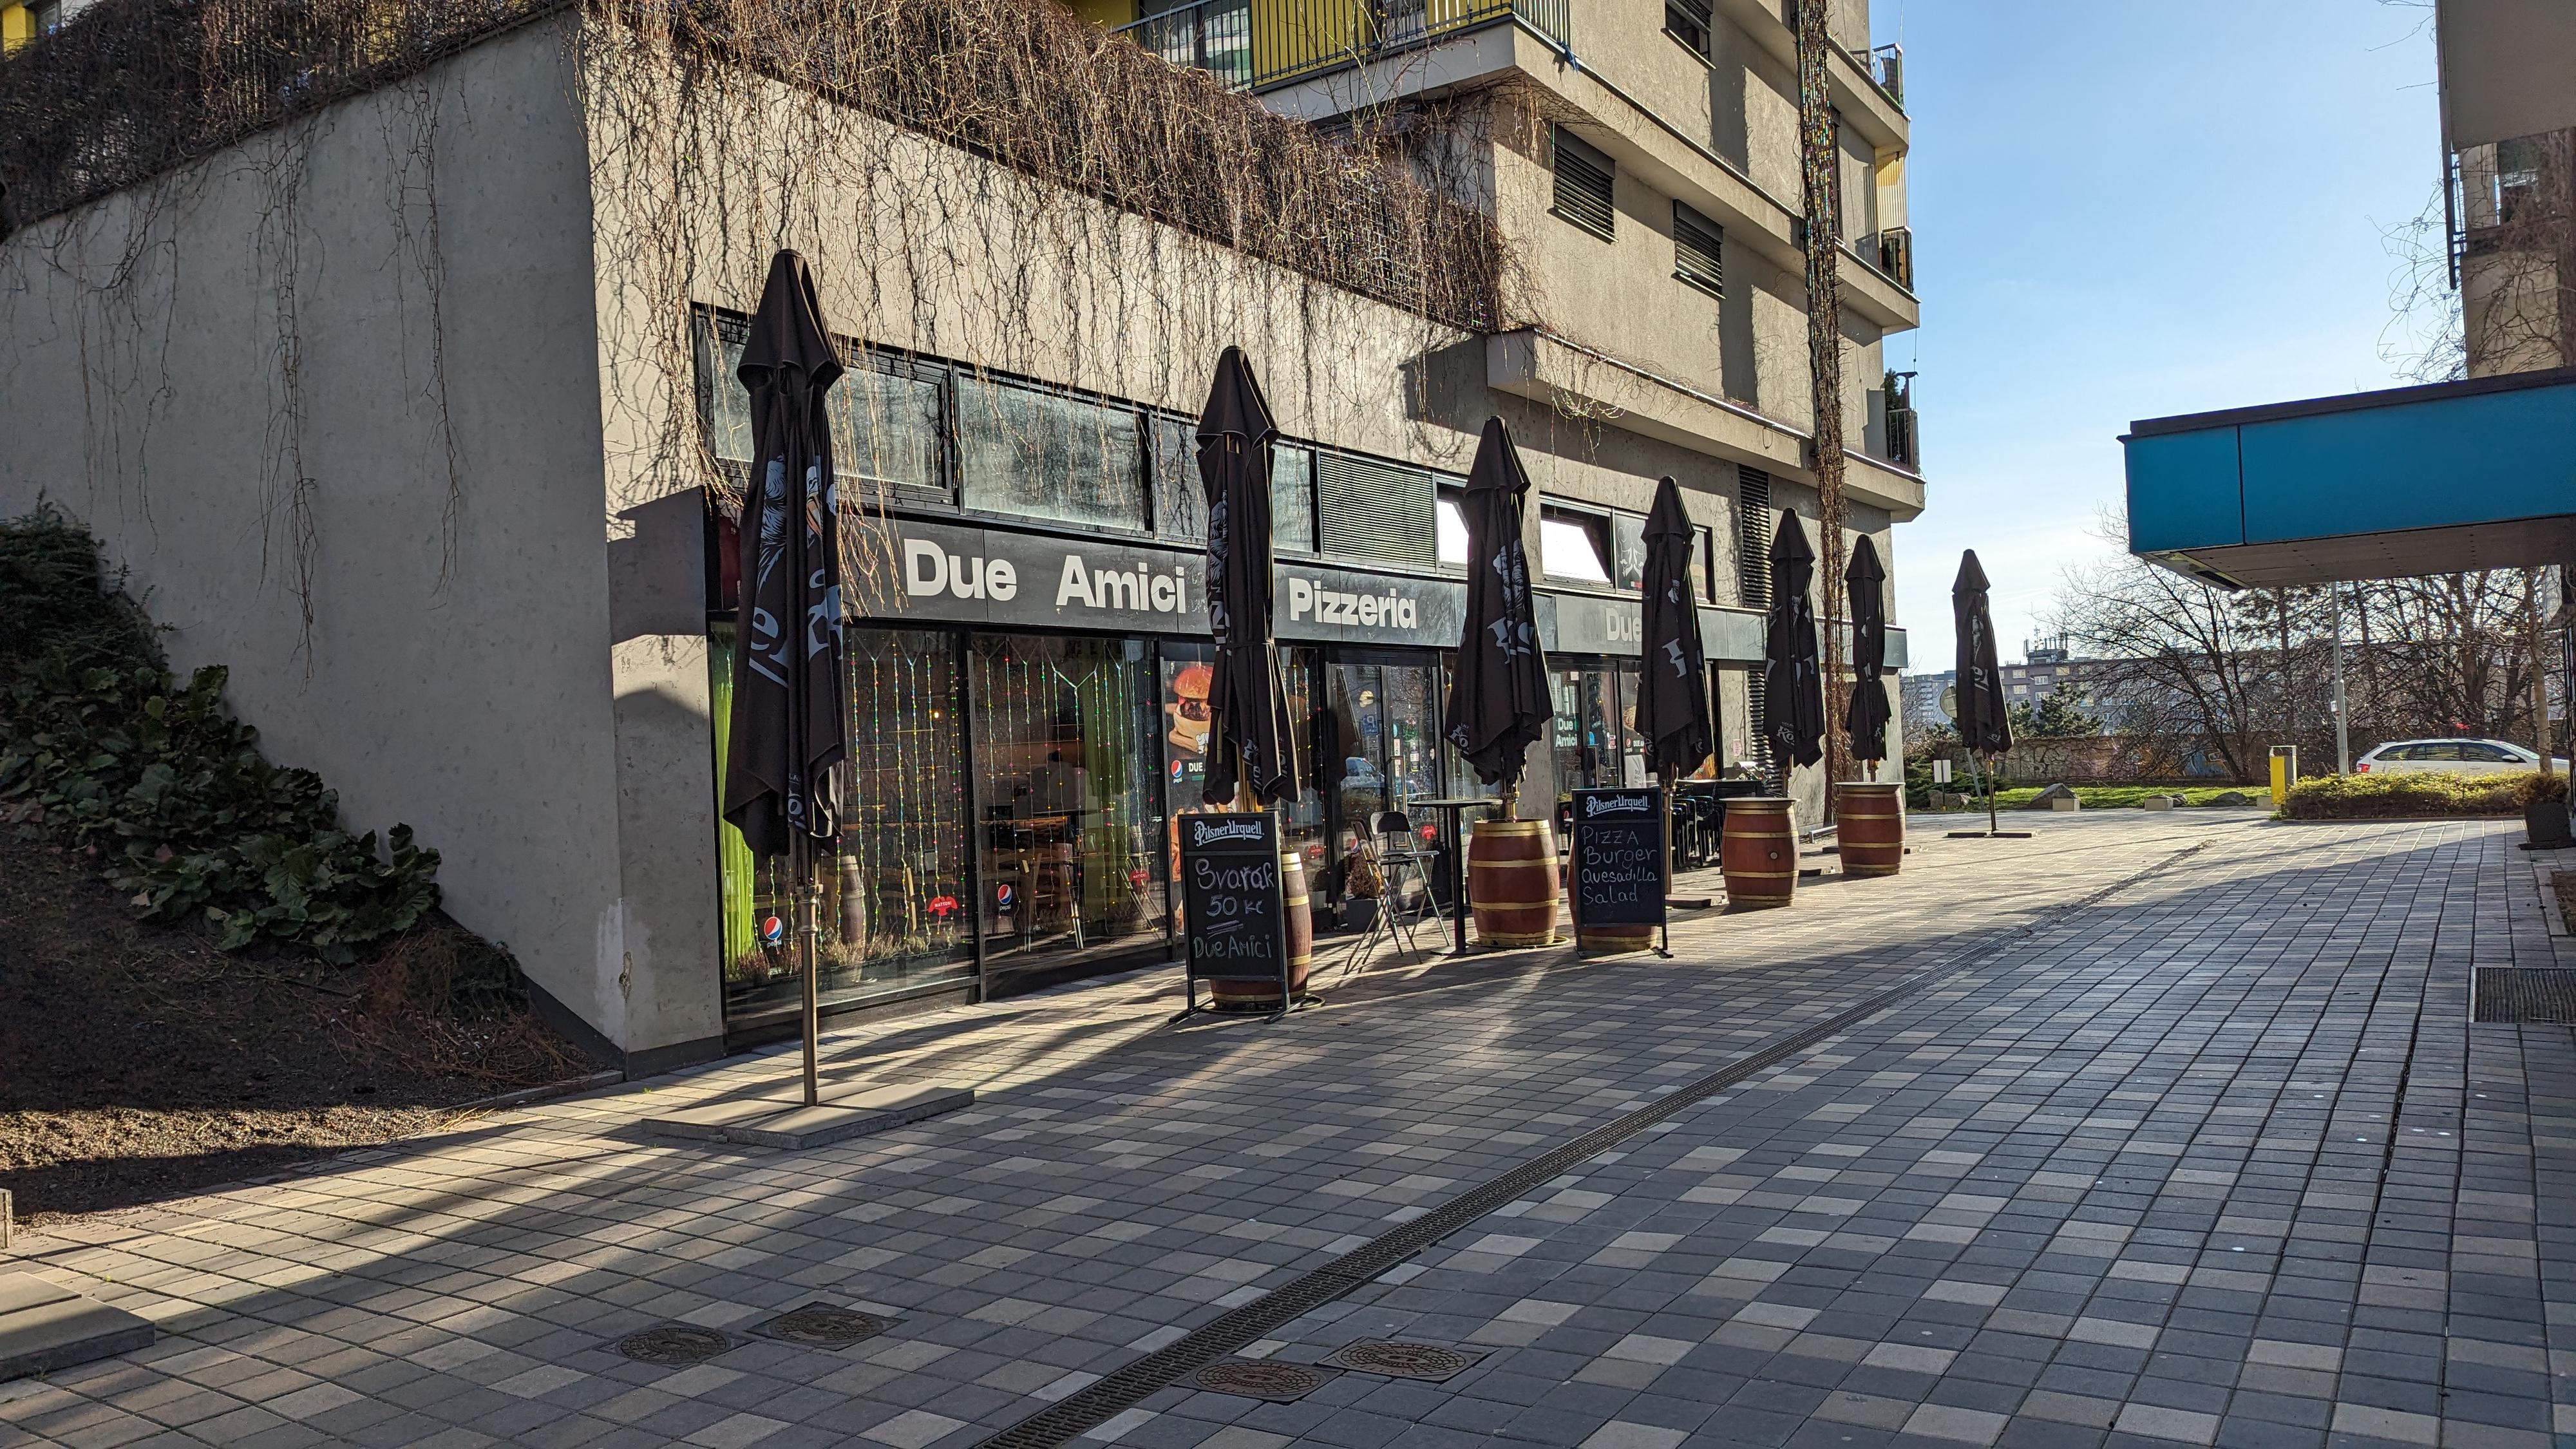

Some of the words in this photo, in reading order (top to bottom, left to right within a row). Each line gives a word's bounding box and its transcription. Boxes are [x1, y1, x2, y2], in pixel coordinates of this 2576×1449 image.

[904, 538, 1018, 601] Due
[1056, 554, 1186, 614] Amici
[1289, 577, 1417, 629] Pizzeria
[1606, 607, 1642, 642] Due
[1558, 717, 1573, 731] Due
[1555, 734, 1577, 747] Amici
[1188, 762, 1203, 772] DUE
[1586, 795, 1618, 818] Pilsner
[1194, 820, 1229, 847] Pilsner
[1584, 846, 1657, 869] Burger
[1582, 866, 1658, 884] Quesadilla
[1206, 894, 1237, 917] 50
[1583, 884, 1638, 905] Salad
[1193, 936, 1226, 958] Due
